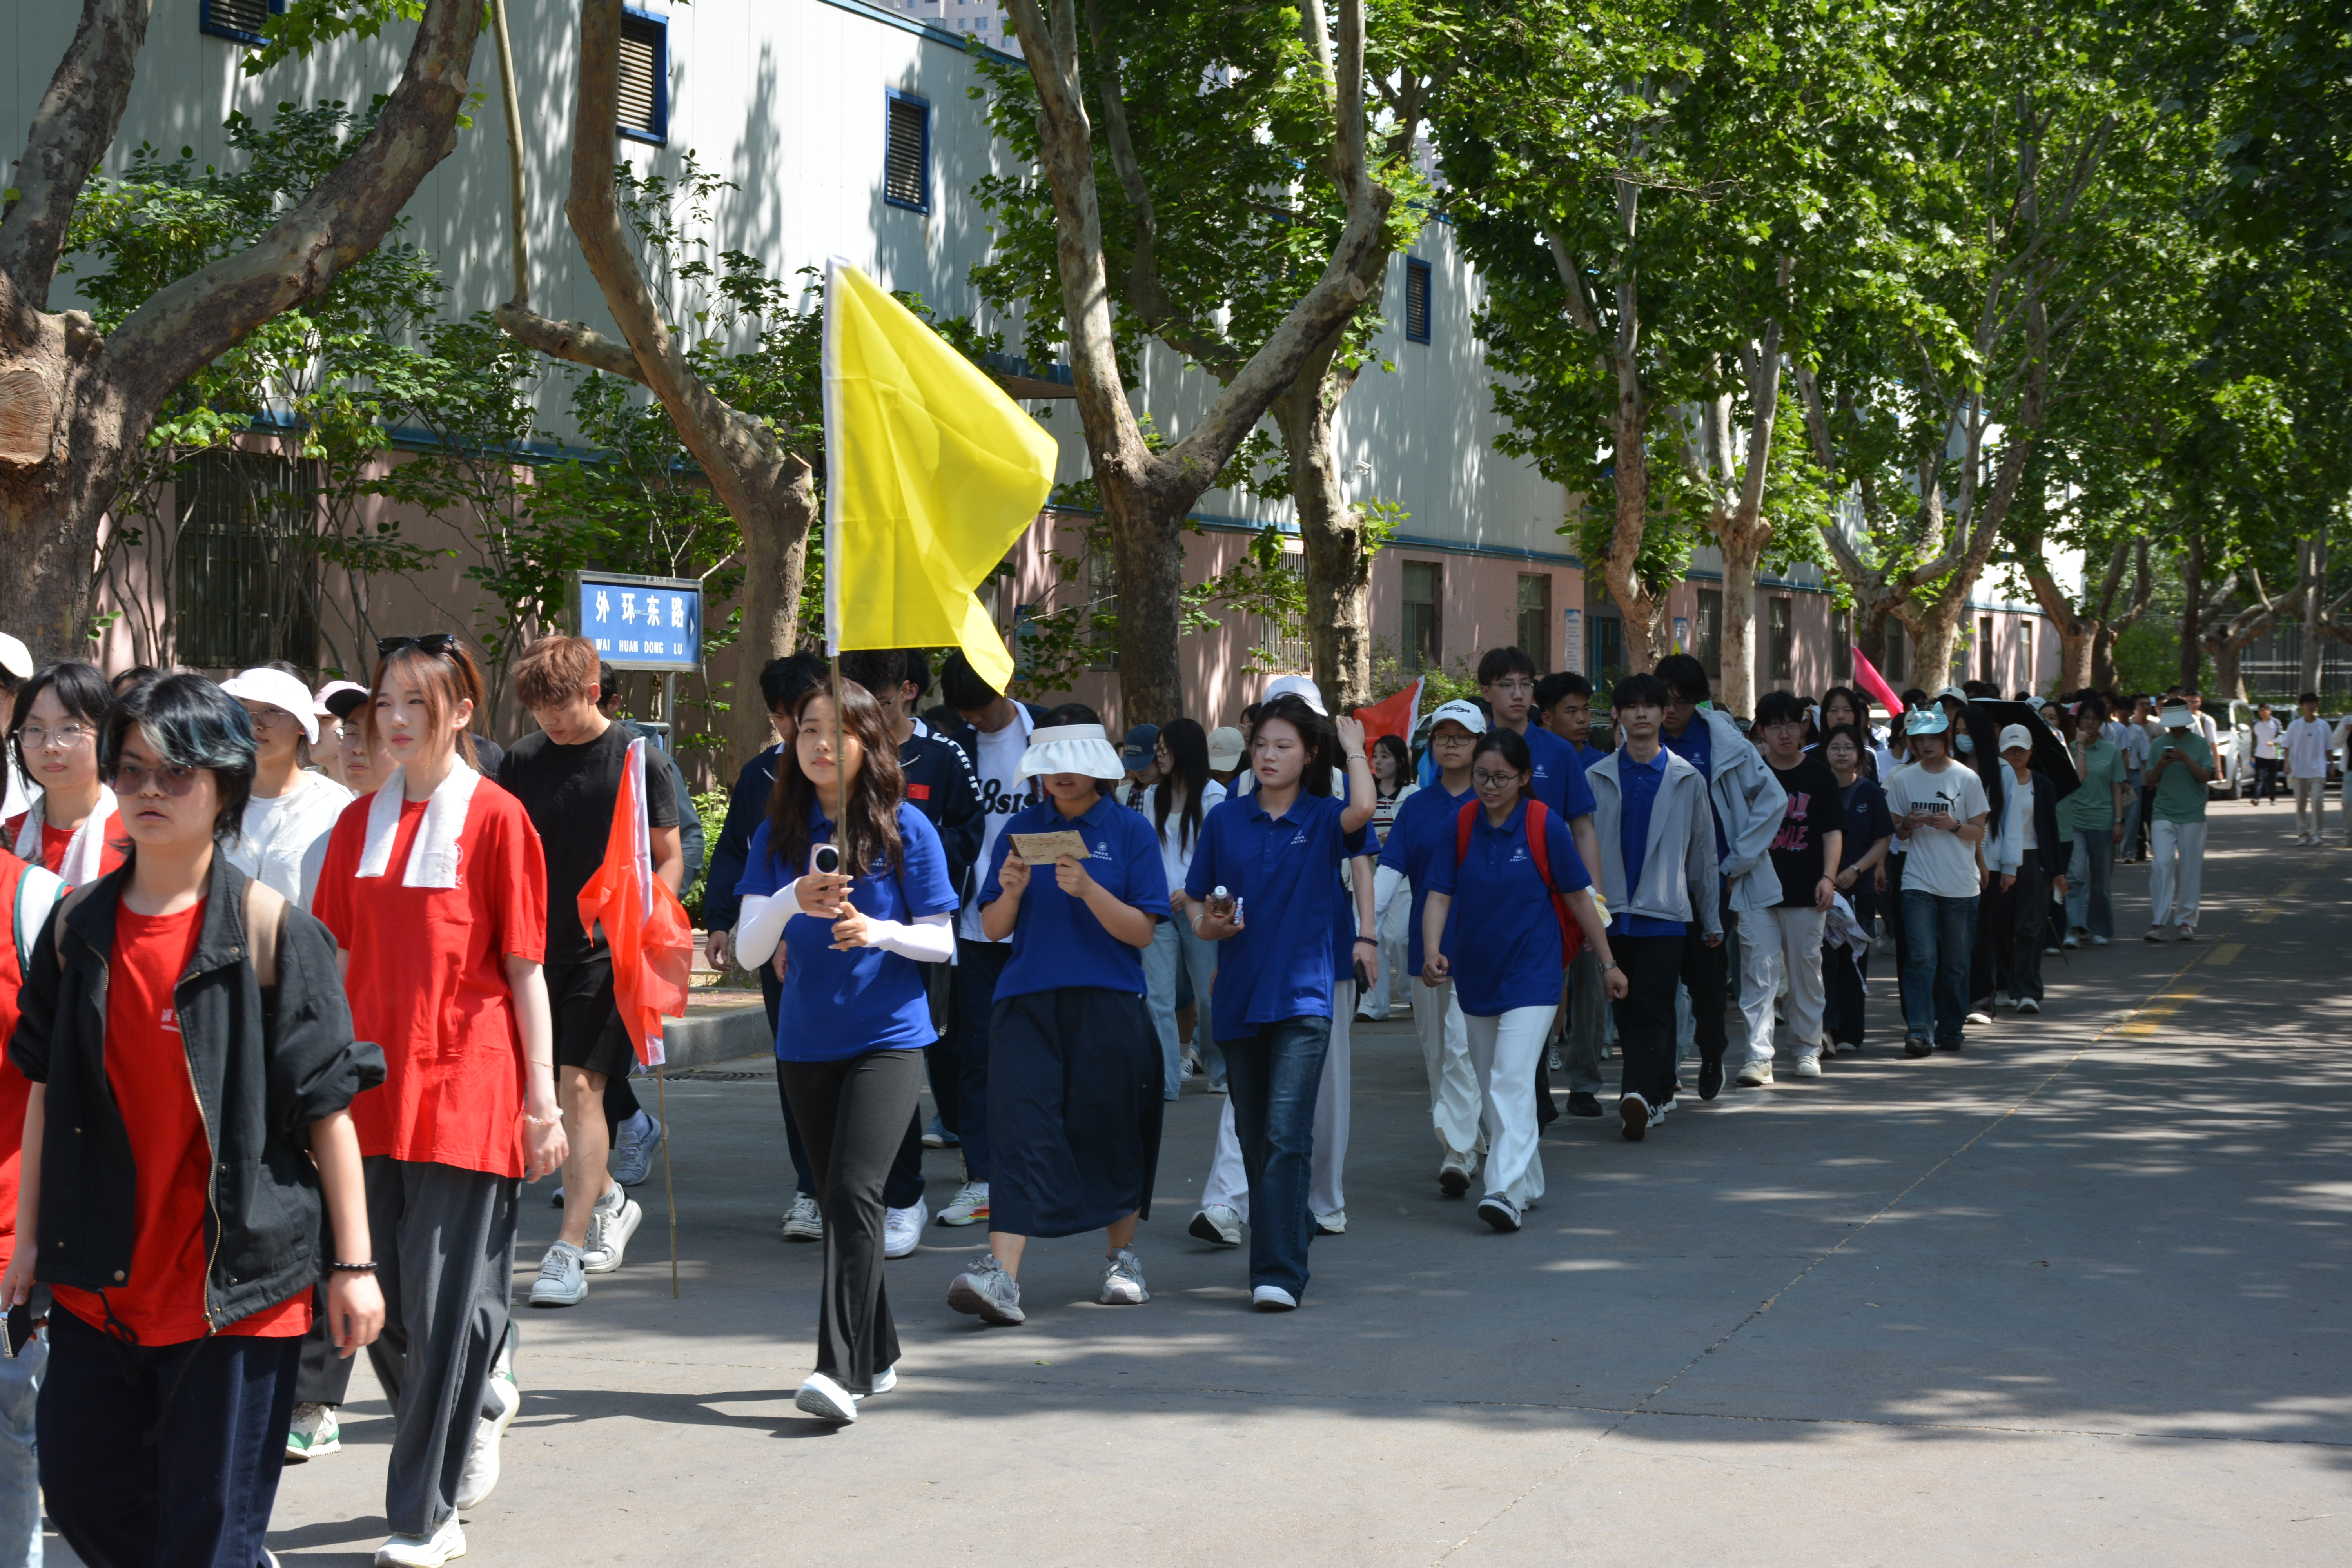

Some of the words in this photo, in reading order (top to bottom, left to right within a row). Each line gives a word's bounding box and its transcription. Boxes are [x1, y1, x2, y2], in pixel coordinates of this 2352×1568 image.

[595, 590, 684, 628] 外环东路
[595, 639, 610, 651] WAI
[619, 640, 638, 653] HUAN
[644, 642, 664, 654] DONG
[673, 643, 682, 655] LU
